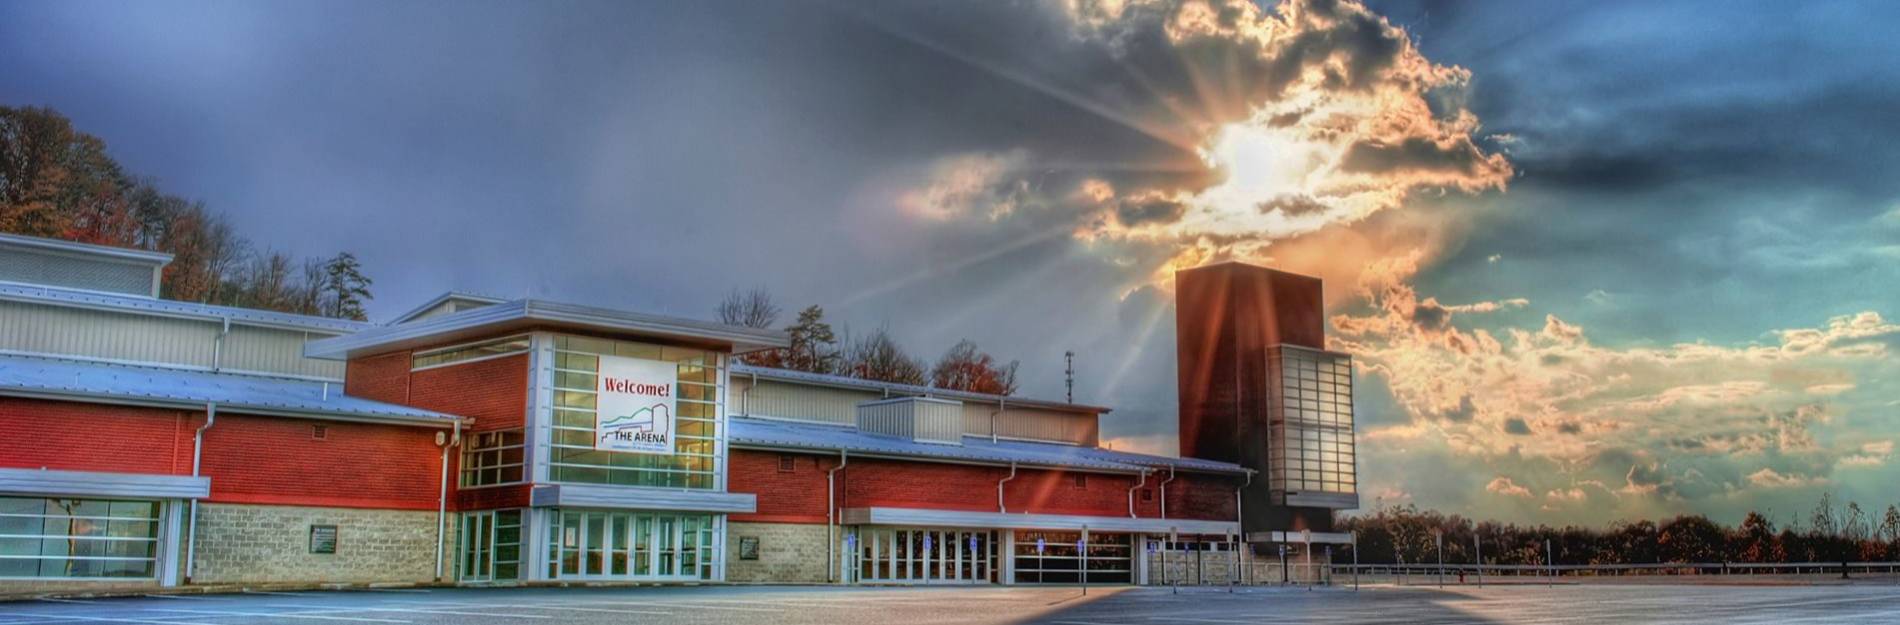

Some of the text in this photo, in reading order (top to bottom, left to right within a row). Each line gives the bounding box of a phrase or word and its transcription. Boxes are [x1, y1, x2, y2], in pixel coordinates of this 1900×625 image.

[605, 377, 670, 397] Welcome!
[615, 431, 666, 444] THE ARENA
